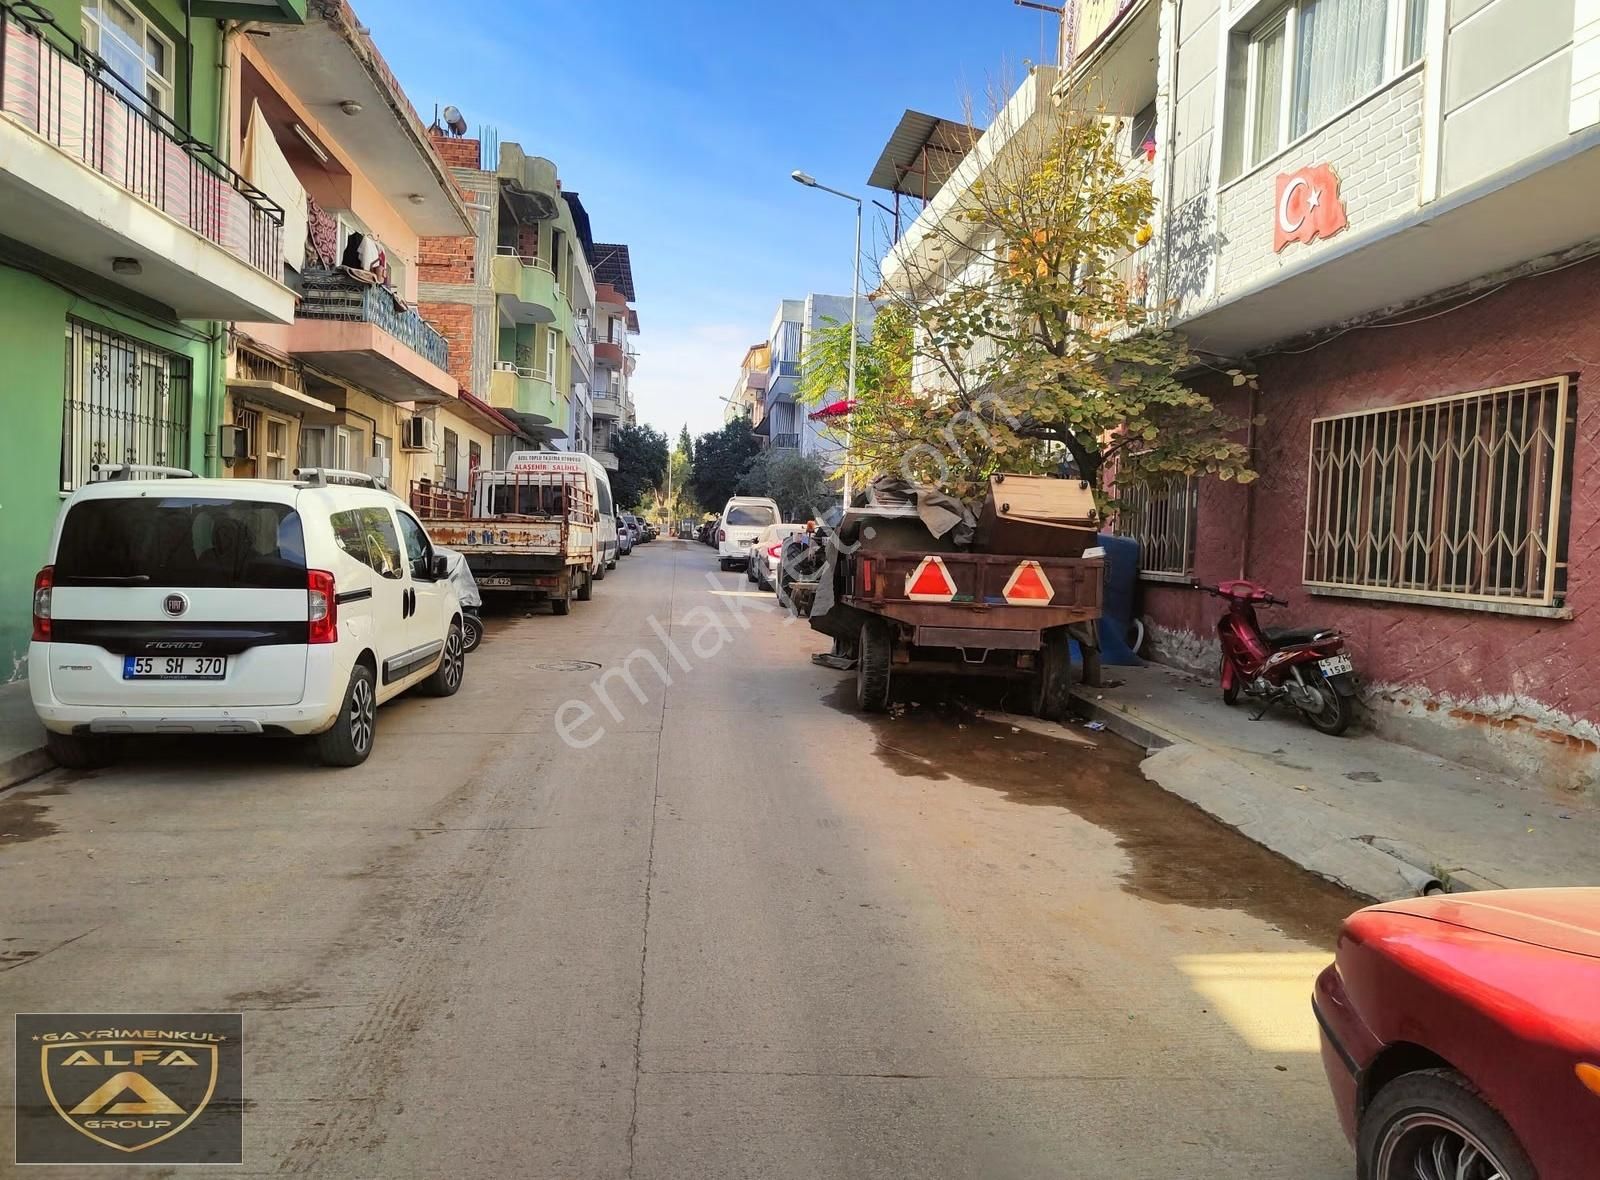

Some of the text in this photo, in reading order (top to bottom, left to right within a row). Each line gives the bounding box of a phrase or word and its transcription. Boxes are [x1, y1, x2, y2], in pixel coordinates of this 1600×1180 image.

[168, 600, 182, 610] FIAT
[145, 641, 204, 649] FIORINO
[135, 658, 222, 673] 55 SH 370
